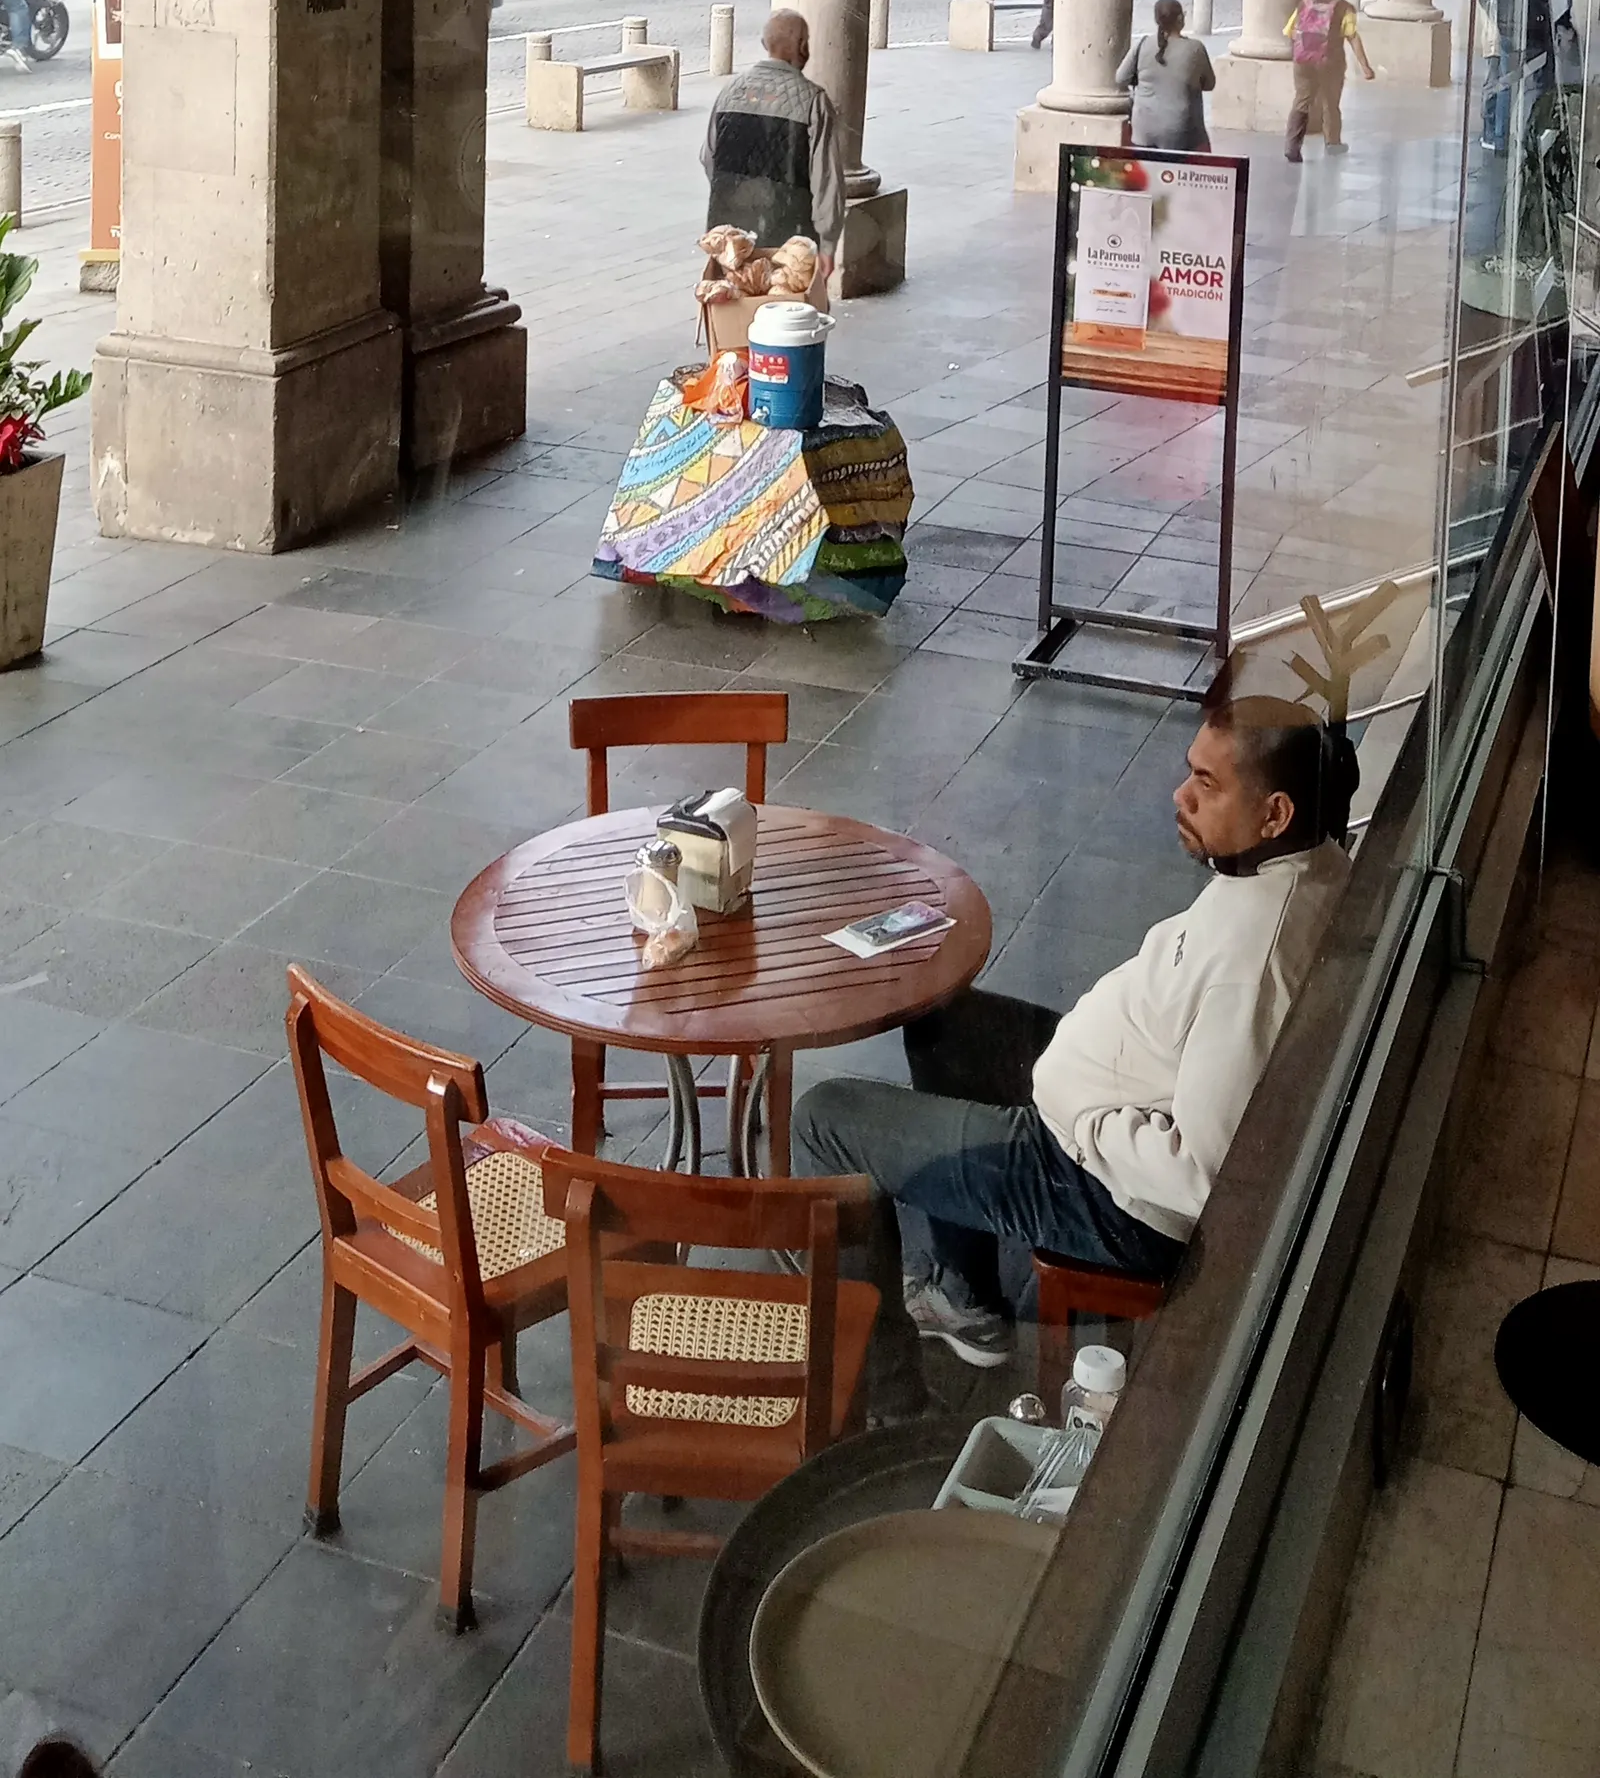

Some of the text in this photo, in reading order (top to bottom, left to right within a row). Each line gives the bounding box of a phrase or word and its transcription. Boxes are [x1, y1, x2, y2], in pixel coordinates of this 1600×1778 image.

[1178, 170, 1229, 184] La Parroquia
[1088, 247, 1140, 262] La Parroquia
[1160, 251, 1226, 270] REGALA
[1159, 267, 1224, 288] AMOR
[1166, 286, 1224, 301] TRADICIÓN
